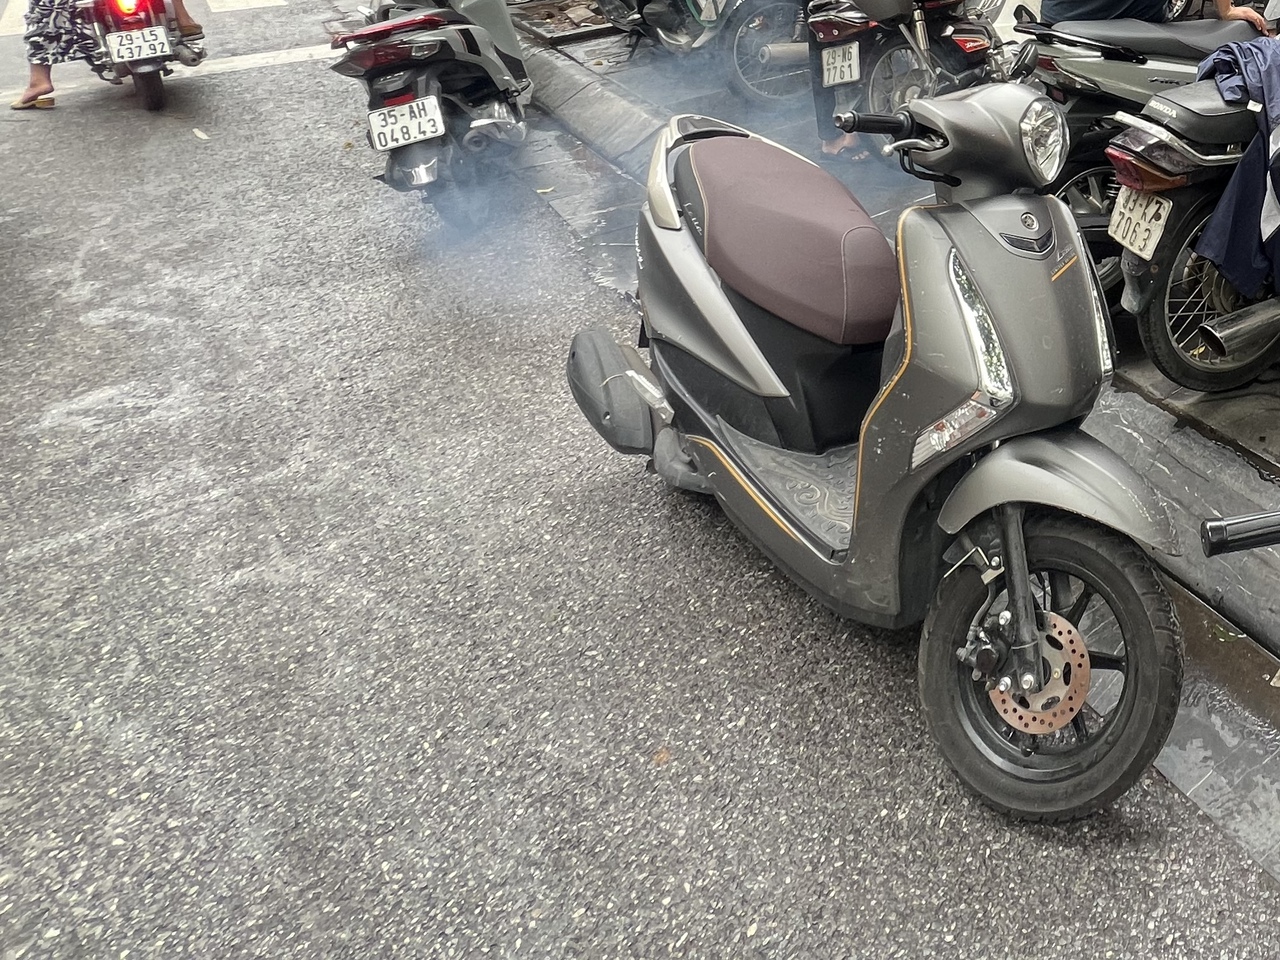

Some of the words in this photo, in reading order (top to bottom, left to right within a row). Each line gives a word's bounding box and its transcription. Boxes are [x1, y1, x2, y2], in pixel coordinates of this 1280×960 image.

[116, 30, 158, 46] 29-L5
[117, 42, 168, 59] 437.92
[826, 63, 853, 84] 7761
[377, 101, 428, 128] 35-AH
[1148, 100, 1177, 118] HONDA
[377, 118, 439, 148] 048.43
[1113, 210, 1152, 252] 7063
